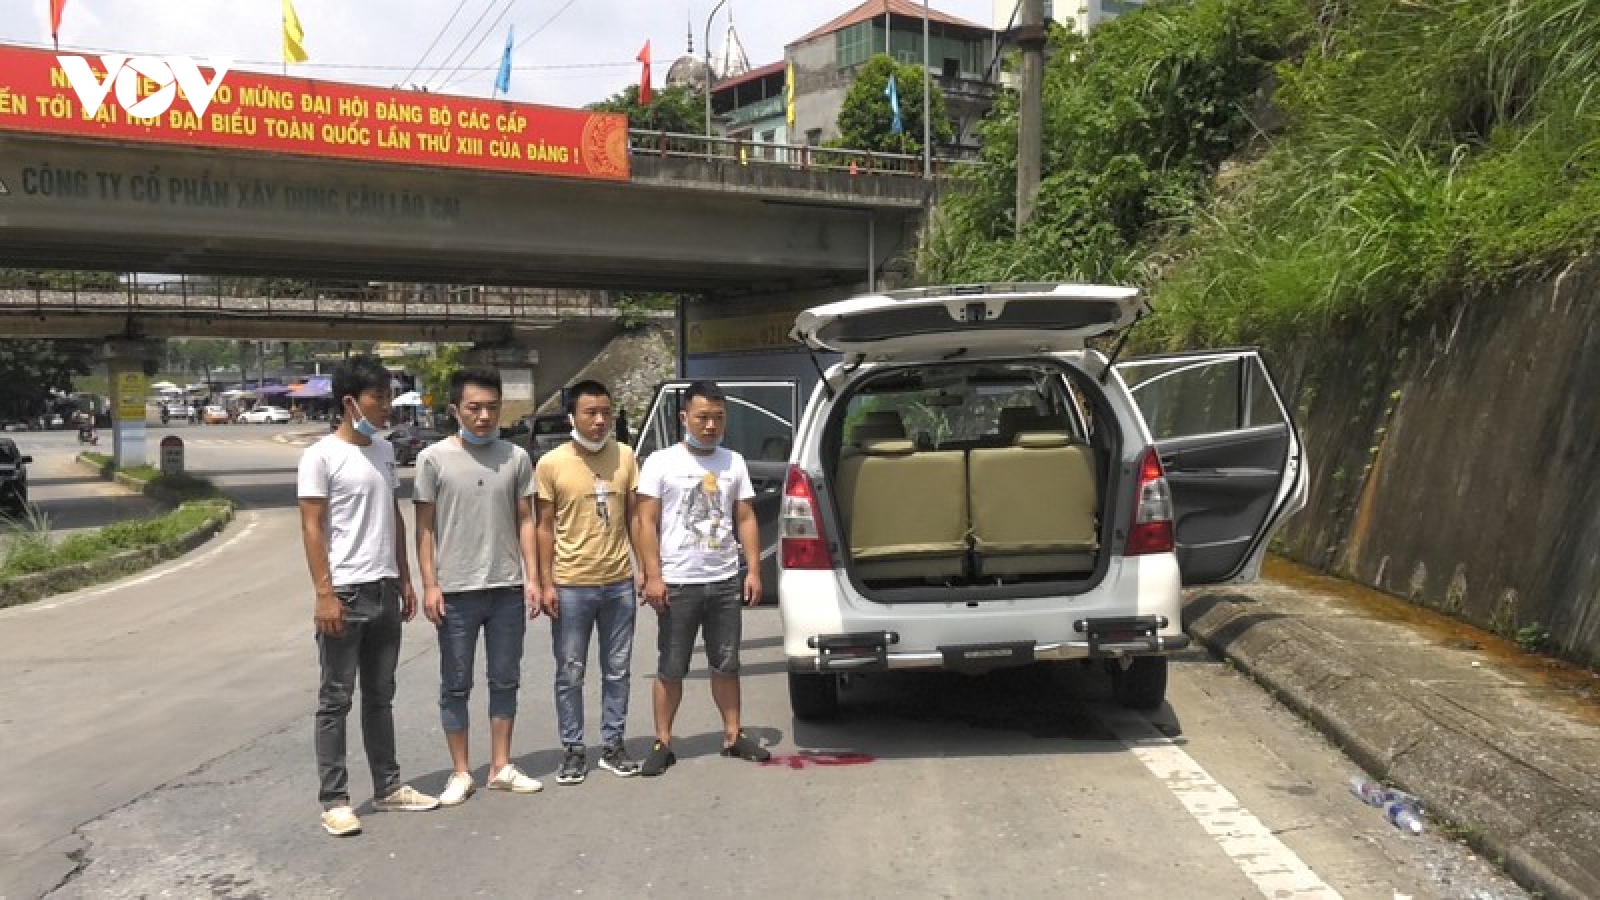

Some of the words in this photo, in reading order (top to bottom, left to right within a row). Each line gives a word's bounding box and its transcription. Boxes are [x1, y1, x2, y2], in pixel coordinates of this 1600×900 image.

[301, 92, 331, 119] ĐẠI
[338, 95, 369, 119] HỘI
[375, 97, 423, 123] ĐẢNG
[457, 110, 490, 131] CÁC
[264, 115, 315, 141] TOÀN
[322, 119, 371, 146] QUỐC
[457, 136, 483, 156] XIII
[489, 136, 521, 159] CỦA
[527, 138, 569, 163] ĐẢNG
[22, 163, 88, 197] CÔNG
[96, 171, 123, 202] TY
